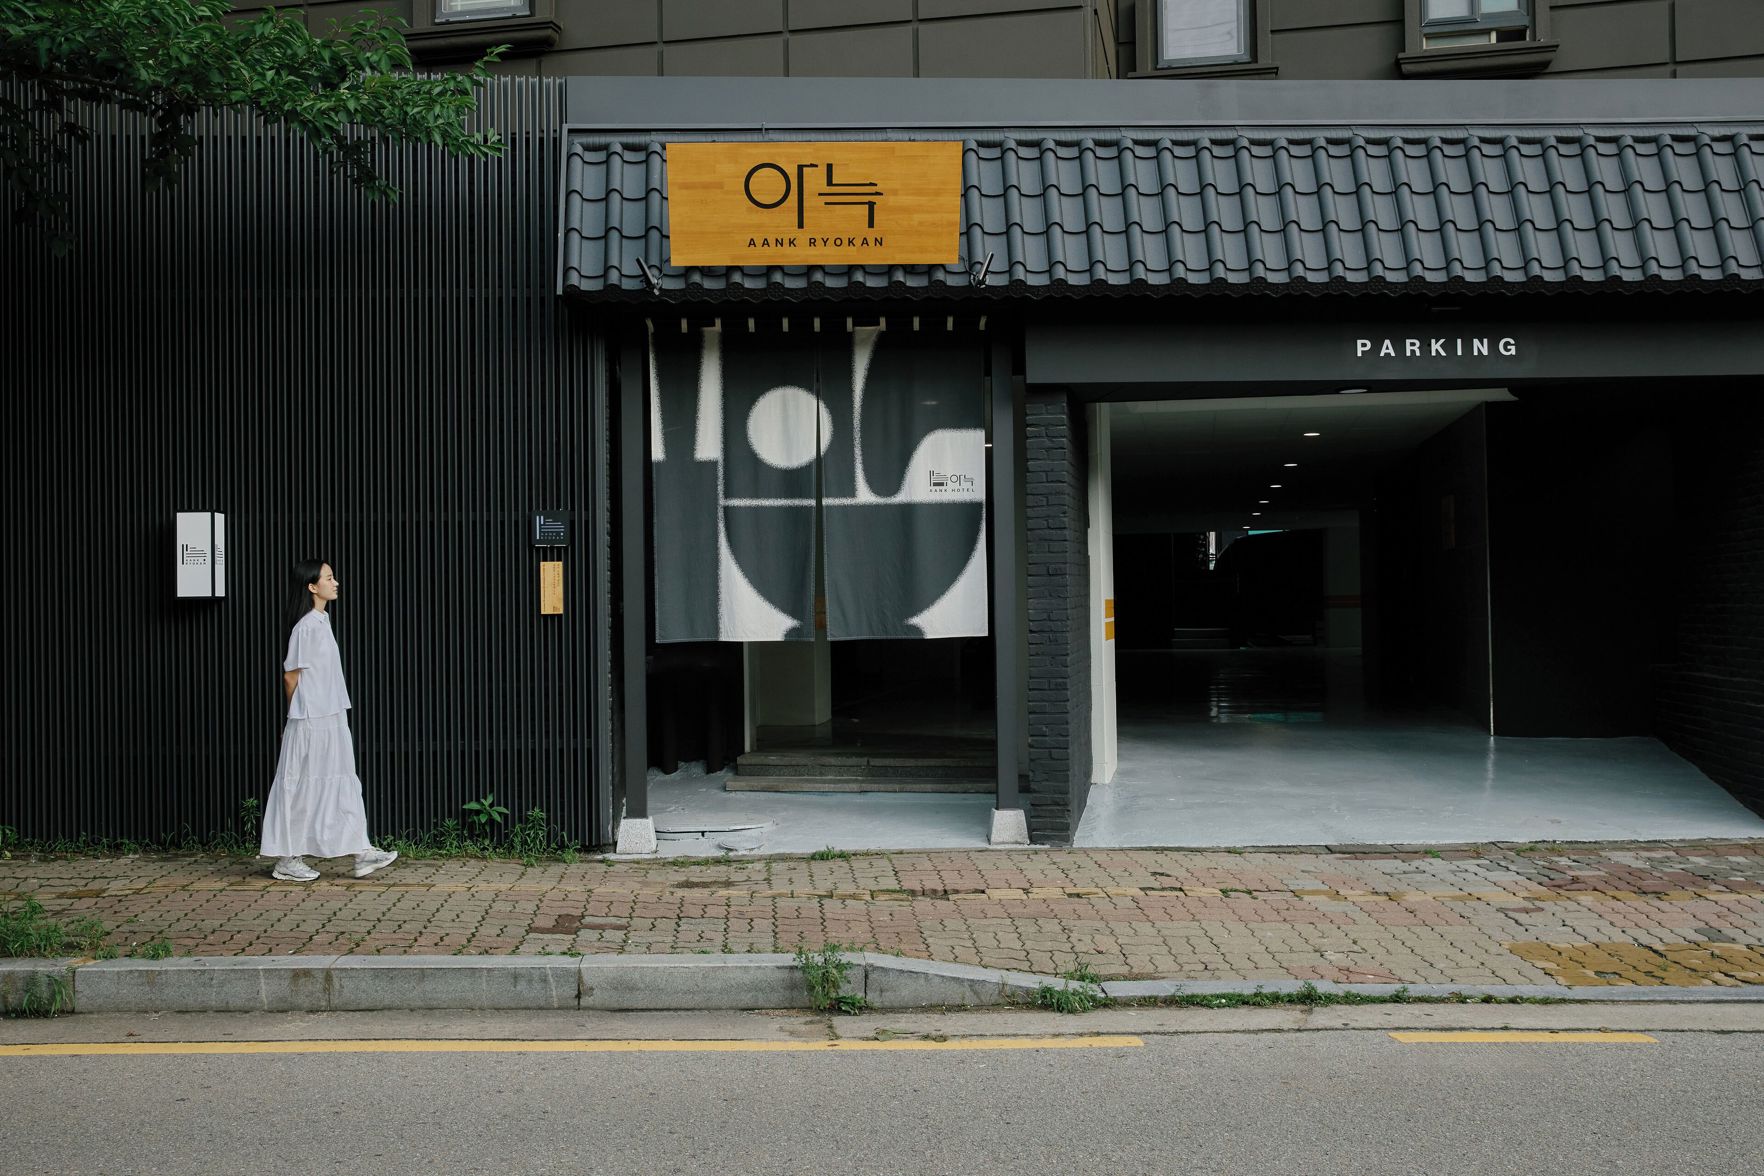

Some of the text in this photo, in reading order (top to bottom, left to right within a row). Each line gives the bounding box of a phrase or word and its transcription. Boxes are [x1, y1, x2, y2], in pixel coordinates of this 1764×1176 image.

[747, 236, 884, 248] AANK RYOKAN
[1356, 337, 1517, 357] PARKING
